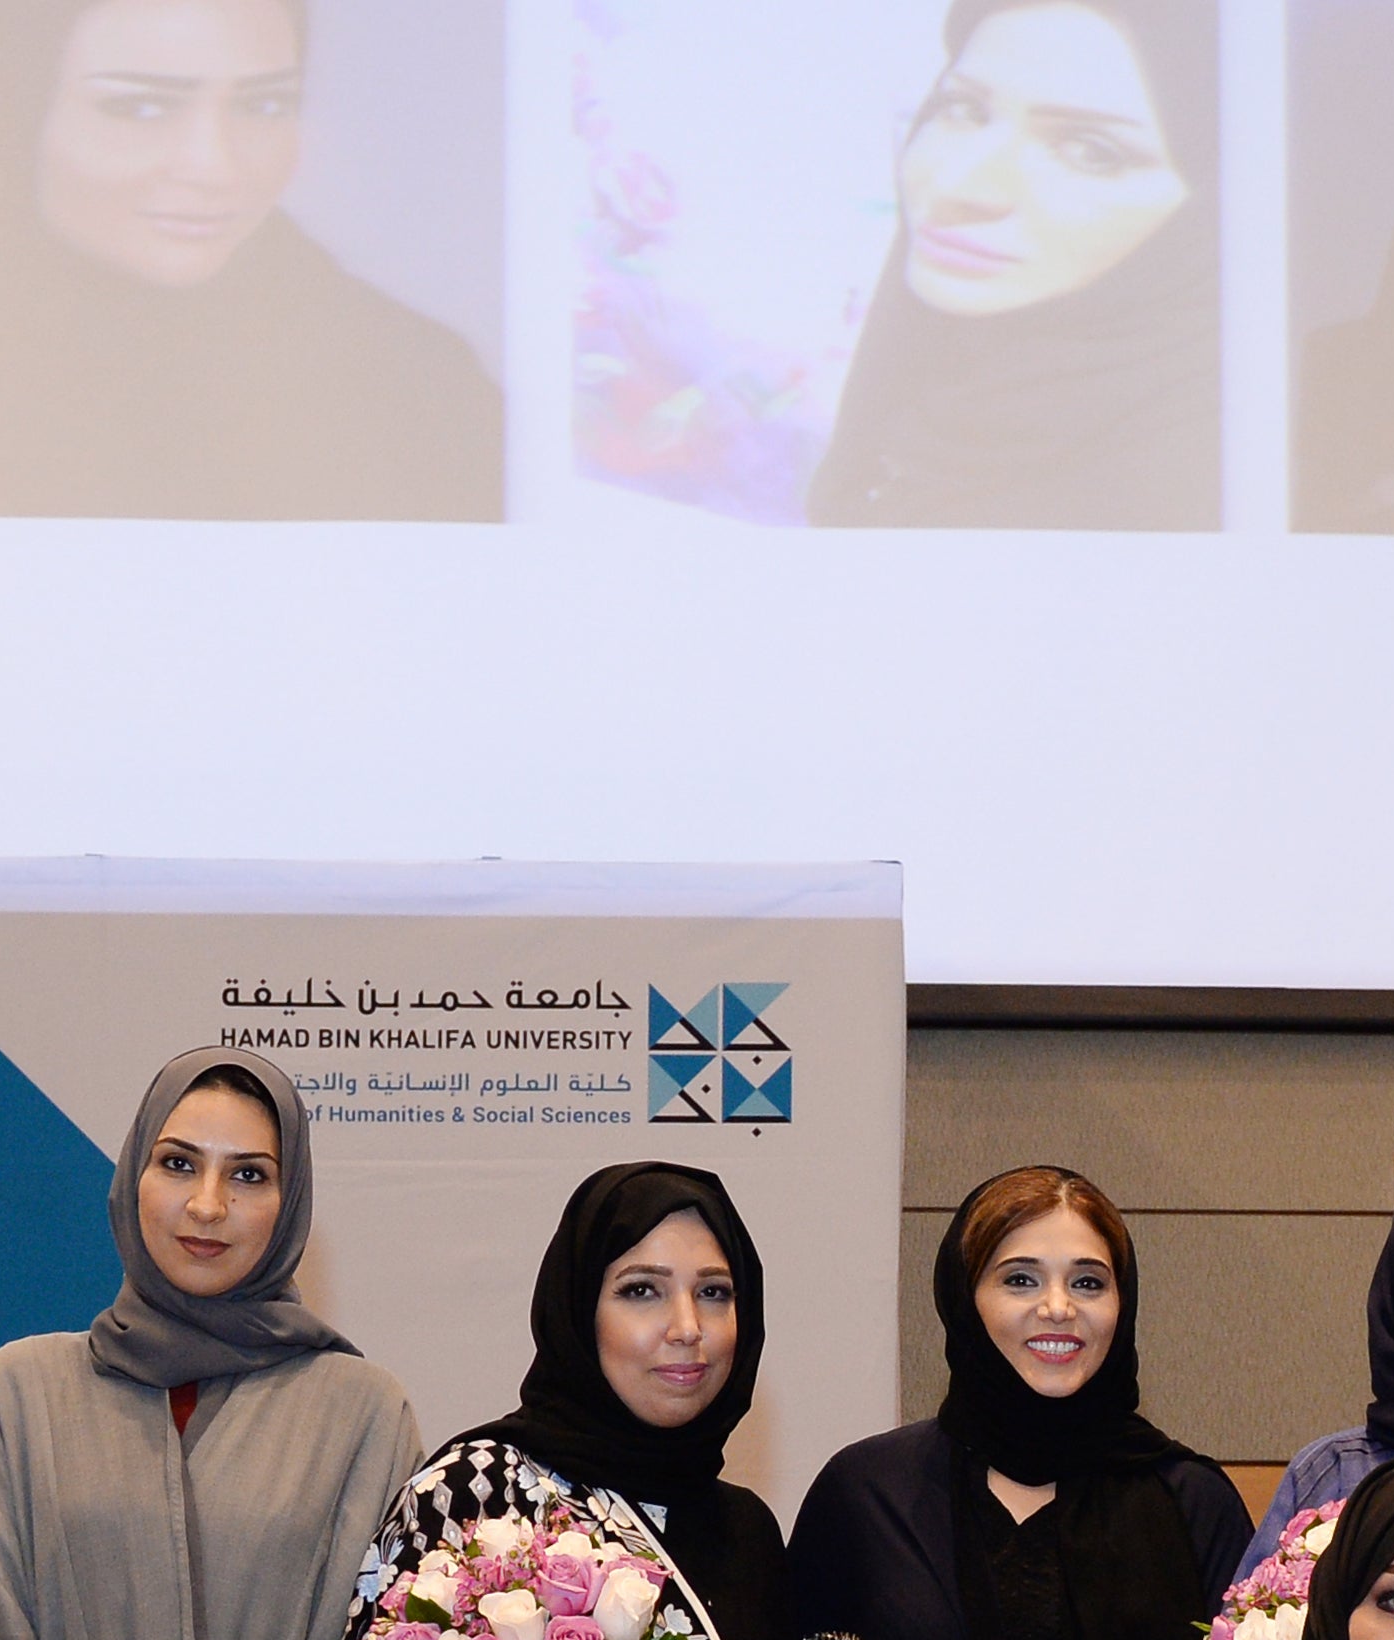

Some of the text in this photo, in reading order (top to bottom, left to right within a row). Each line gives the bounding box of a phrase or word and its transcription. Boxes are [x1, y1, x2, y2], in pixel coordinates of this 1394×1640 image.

[221, 977, 632, 1018] جامعة حمد بن خليفة
[221, 1028, 632, 1051] HAMAD BIN KHALIFA UNIVERSITY
[294, 1072, 358, 1096] والاجت
[480, 1072, 559, 1097] العلوم
[328, 1105, 446, 1123] Humanities
[451, 1106, 466, 1123] &
[472, 1106, 534, 1124] Social
[541, 1106, 632, 1124] Sciences
